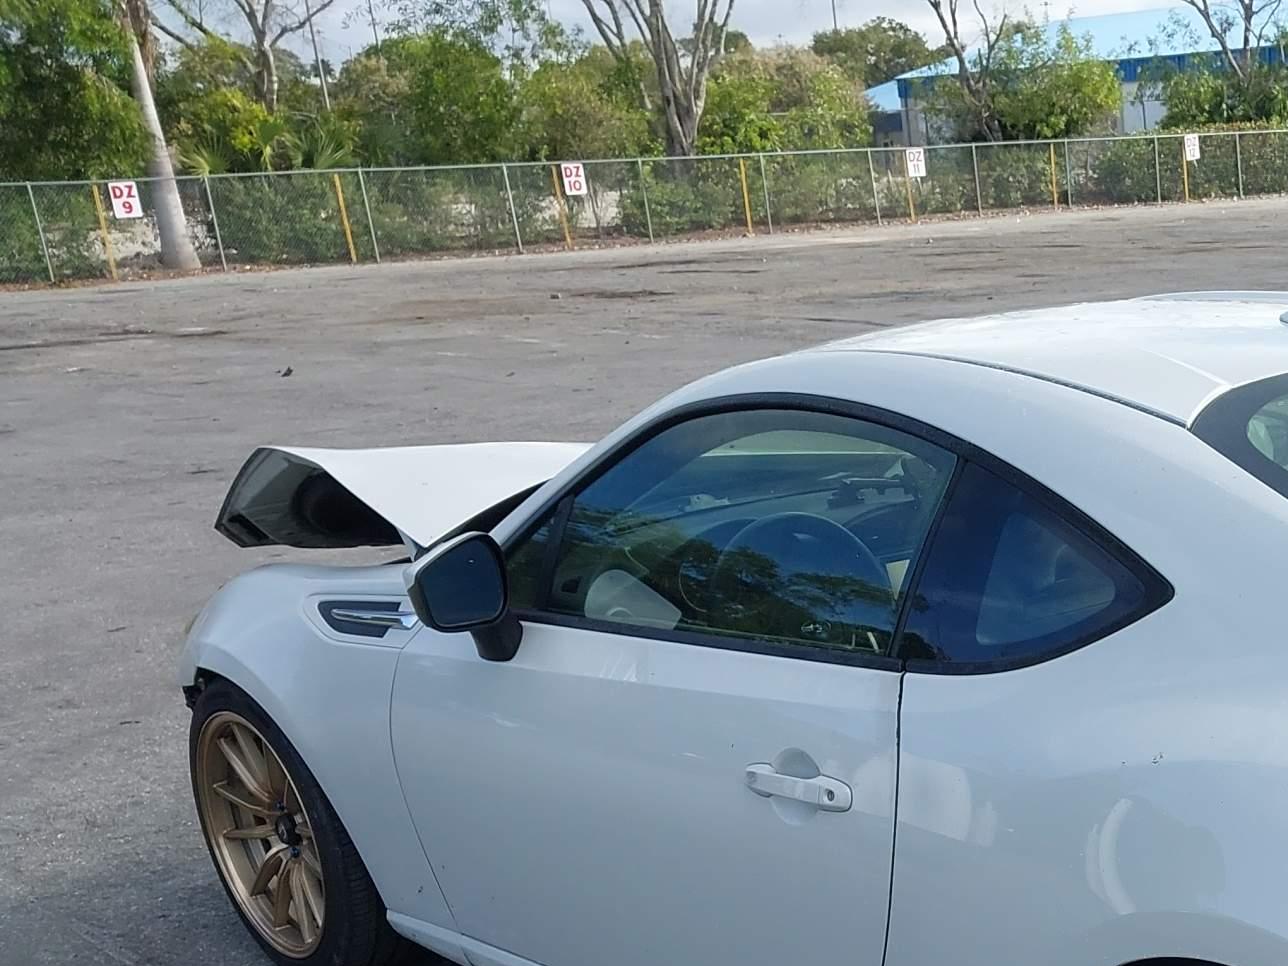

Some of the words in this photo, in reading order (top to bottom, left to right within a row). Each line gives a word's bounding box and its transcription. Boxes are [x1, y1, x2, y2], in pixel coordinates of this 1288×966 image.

[908, 151, 922, 162] DZ
[563, 166, 582, 178] DZ
[912, 162, 920, 174] 11
[111, 185, 136, 199] DZ
[568, 180, 582, 192] 10
[122, 201, 133, 214] 9
